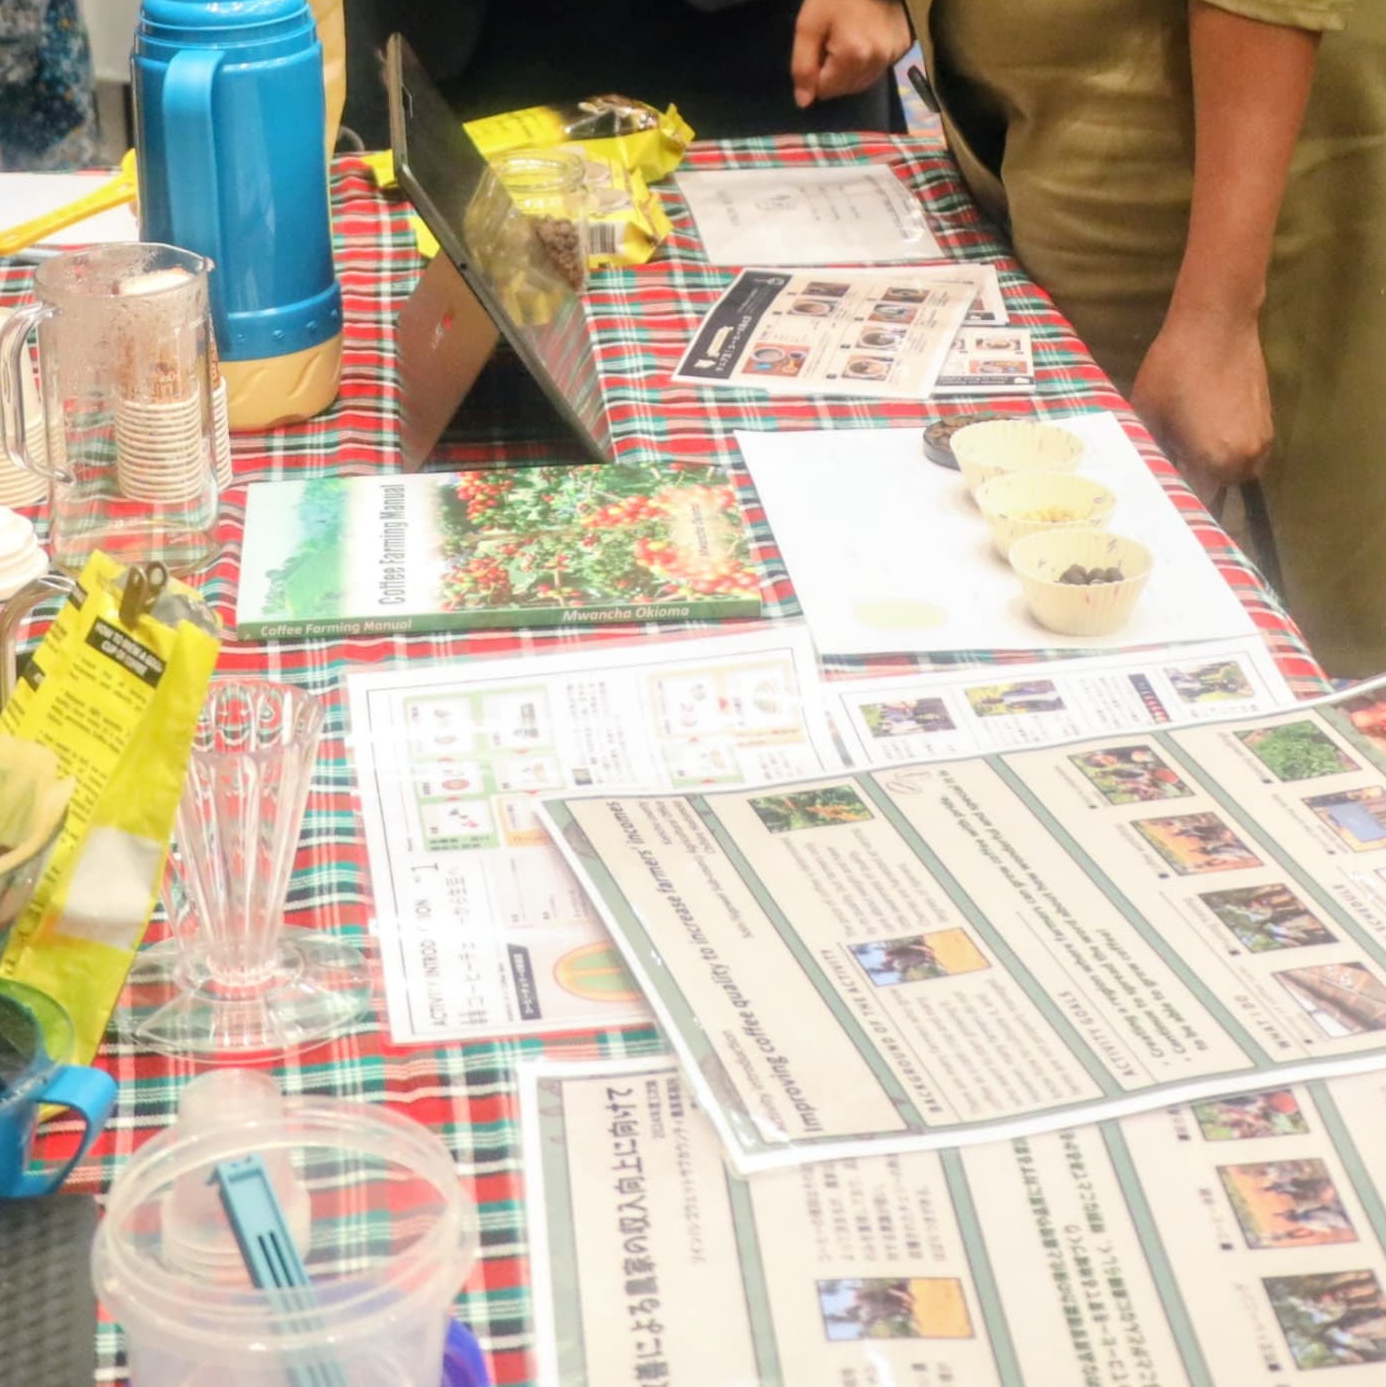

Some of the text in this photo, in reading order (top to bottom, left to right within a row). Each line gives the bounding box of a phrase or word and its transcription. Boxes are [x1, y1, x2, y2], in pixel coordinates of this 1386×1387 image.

[379, 483, 409, 605] Coffee Farming Manual
[260, 618, 413, 637] Coffee Farming Manual
[562, 605, 690, 623] Mwancha Okioma
[953, 818, 980, 838] with
[970, 838, 1003, 865] coffee
[996, 865, 1027, 889] grow
[1015, 888, 1038, 905] can
[934, 768, 1190, 1055] Continue to spread the word about how wonderful and special it is
[1028, 904, 1071, 942] farmers
[600, 800, 831, 1133] Improving coffee quality to increase farmers' incomes
[1058, 942, 1096, 974] where
[1123, 961, 1159, 989] grow
[1086, 972, 1127, 1007] region
[1145, 989, 1166, 1001] to
[1231, 993, 1257, 1010] DO
[1156, 1001, 1185, 1024] able
[817, 947, 945, 1114] BACKGROUND OF THE ACTIVITY
[1053, 988, 1139, 1077] ACTIVITY GOALS
[1120, 1014, 1170, 1059] Creating
[1175, 1024, 1198, 1038] be
[1187, 1038, 1209, 1051] to
[1253, 1018, 1292, 1050] WHAT
[604, 1085, 671, 1387] 善による農家の収入向上に向けて
